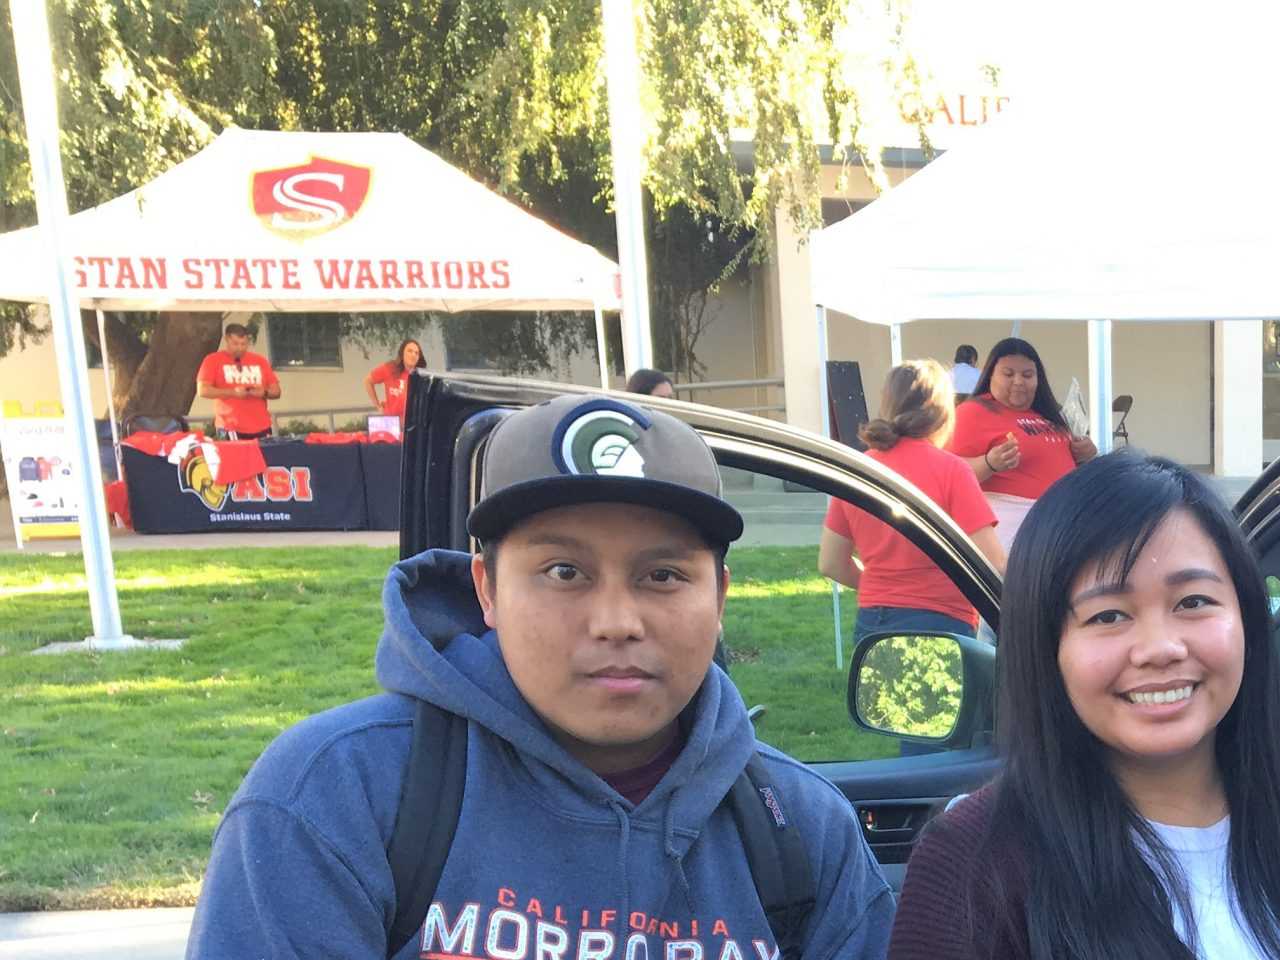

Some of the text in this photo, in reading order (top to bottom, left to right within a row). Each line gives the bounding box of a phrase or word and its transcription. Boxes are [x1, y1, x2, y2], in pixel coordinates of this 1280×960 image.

[73, 256, 511, 289] STAN STATE WARRIORS
[231, 466, 313, 502] ASI
[210, 511, 292, 522] Stanislaus State
[498, 887, 729, 938] CALIFORNIA
